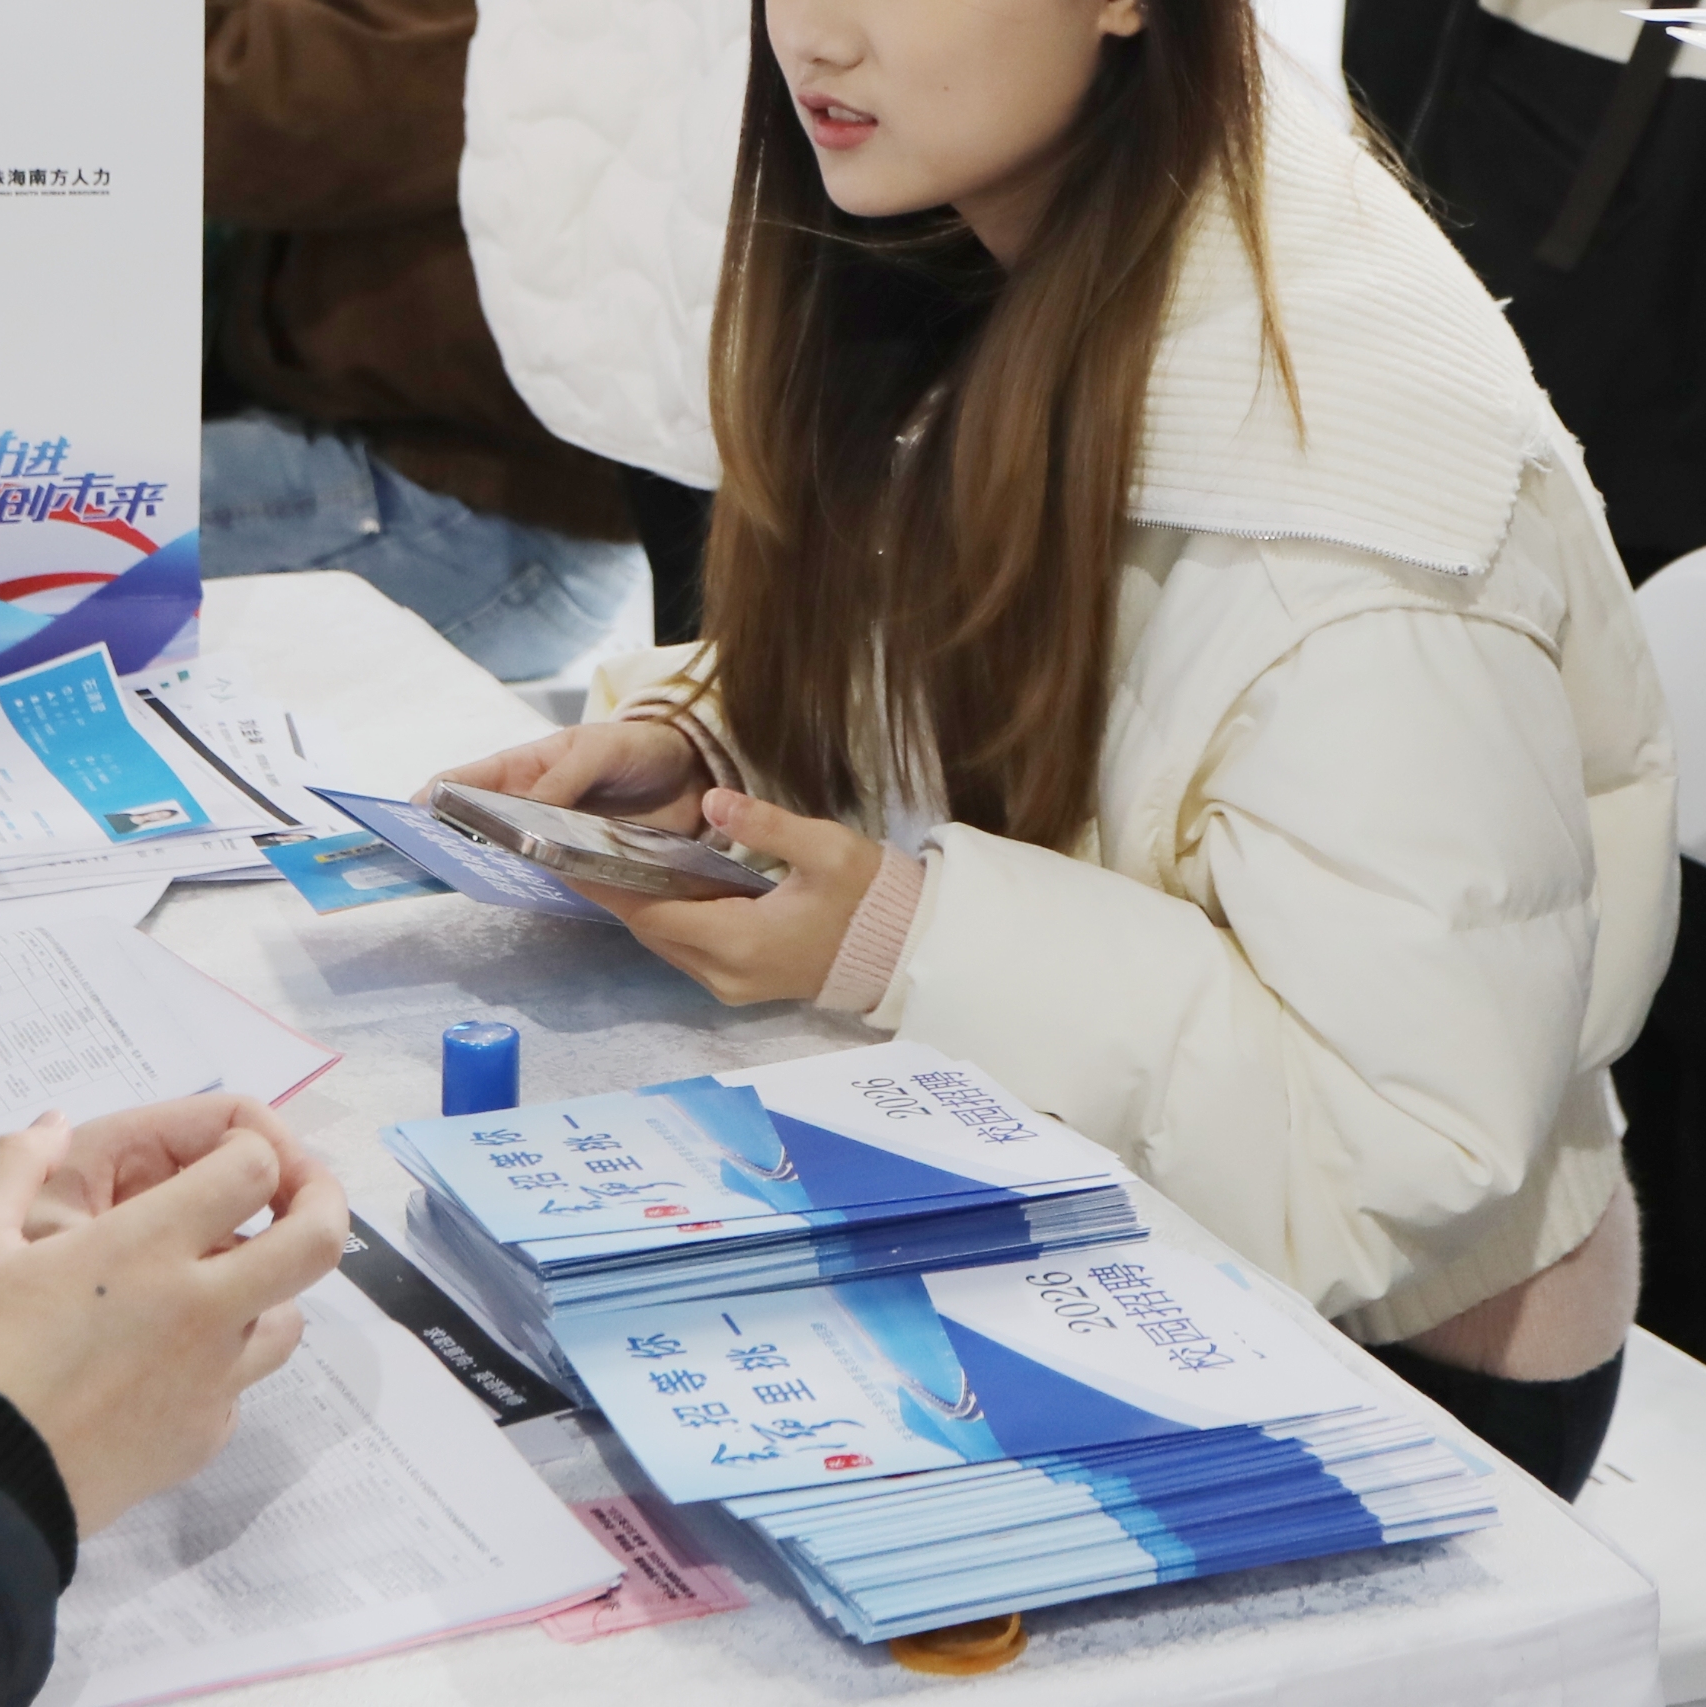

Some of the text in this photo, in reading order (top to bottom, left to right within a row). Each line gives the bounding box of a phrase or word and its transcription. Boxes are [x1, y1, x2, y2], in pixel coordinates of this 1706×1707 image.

[851, 1077, 933, 1120] 2026
[910, 1071, 1039, 1144] 校园招聘
[1025, 1270, 1118, 1334] 2026
[1088, 1262, 1236, 1373] 校园招聘
